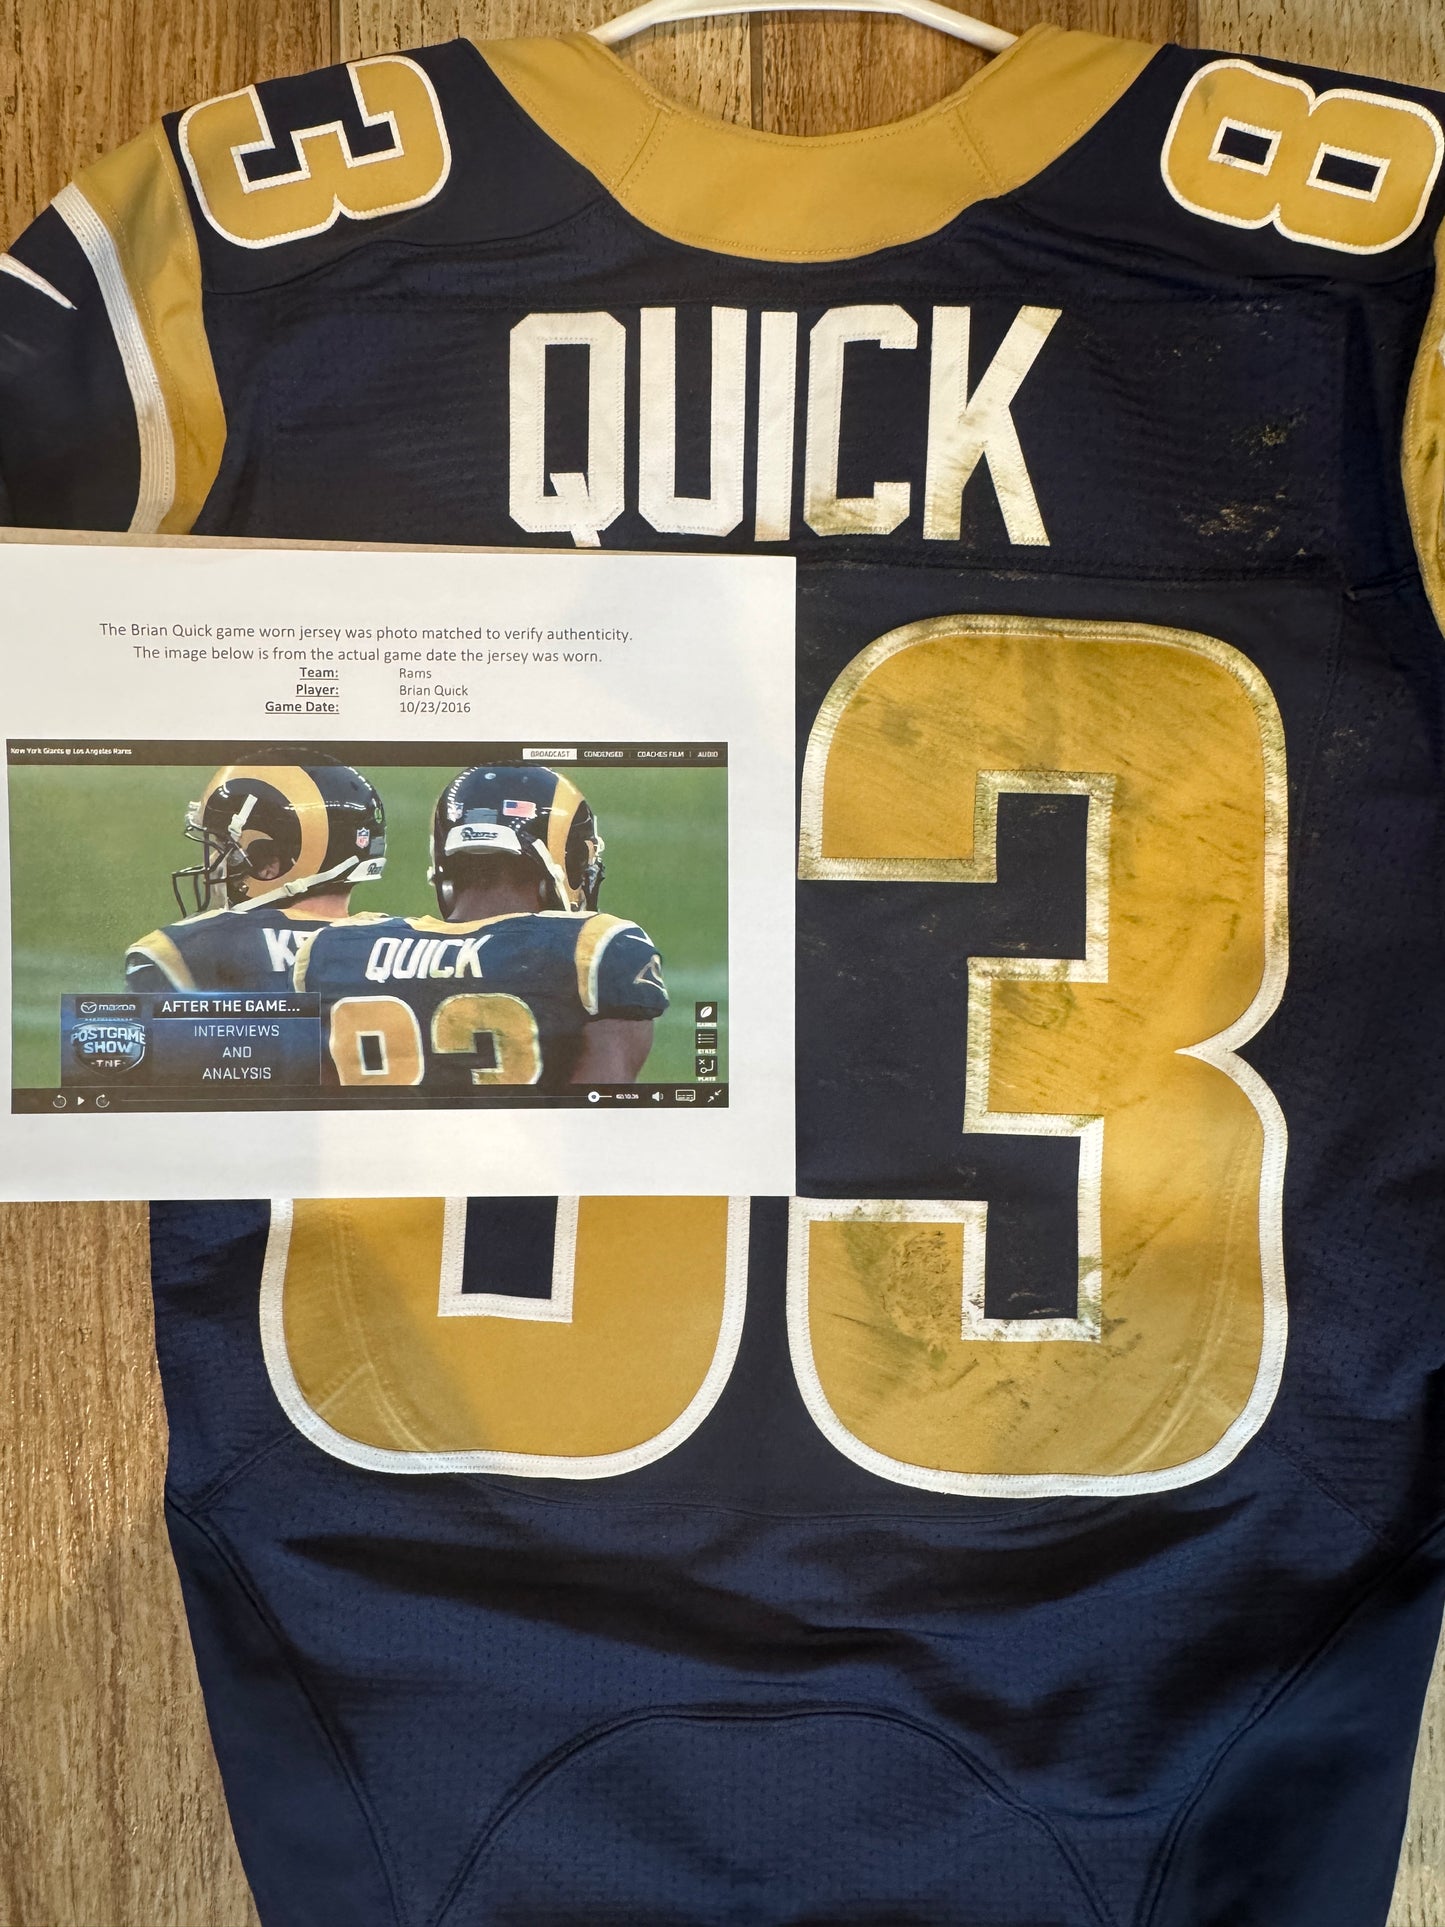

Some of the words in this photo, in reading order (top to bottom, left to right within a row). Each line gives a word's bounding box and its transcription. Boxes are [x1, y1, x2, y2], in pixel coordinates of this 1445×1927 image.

[178, 55, 452, 249] 3
[1161, 59, 1445, 255] 8
[508, 304, 1062, 548] QUICK
[99, 623, 127, 636] The
[131, 624, 168, 637] Brian
[172, 623, 212, 638] Quick
[216, 626, 255, 641] game
[259, 627, 295, 638] worn
[299, 625, 341, 642] jersey
[345, 628, 372, 639] was
[376, 627, 418, 642] photo
[422, 627, 482, 640] matched
[486, 629, 501, 640] to
[504, 627, 543, 643] verify
[547, 628, 633, 643] authenticity.
[133, 646, 160, 659] The
[165, 646, 207, 662] image
[211, 647, 254, 660] below
[258, 648, 269, 660] is
[273, 647, 307, 660] from
[311, 648, 334, 661] the
[338, 648, 380, 661] actual
[383, 651, 422, 664] game
[426, 648, 456, 662] date
[461, 648, 483, 662] the
[487, 649, 529, 665] jersey
[532, 652, 559, 663] was
[562, 652, 603, 663] worn.
[299, 667, 339, 679] Team:
[399, 667, 432, 679] Rams
[295, 684, 339, 697] Player:
[399, 684, 431, 696] Brian
[434, 684, 469, 697] Quick
[264, 701, 302, 713] Game
[305, 701, 339, 713] Date:
[399, 701, 471, 714] 10/23/2016
[27, 747, 42, 755] York
[43, 747, 65, 755] Giants
[73, 747, 84, 755] Los
[85, 747, 112, 756] Angeles
[530, 750, 570, 758] BROADCAST
[584, 750, 624, 758] CONDENSED
[637, 750, 668, 758] COACHES
[669, 750, 684, 758] FILM
[698, 750, 719, 758] AUDIO
[365, 934, 494, 983] QUICK
[98, 1003, 136, 1012] mazda
[162, 1000, 209, 1013] AFTER
[213, 1000, 242, 1013] THE
[245, 1000, 300, 1012] GAME...
[70, 1026, 146, 1045] POSTGAME
[194, 1025, 280, 1037] INTERVIEWS
[83, 1041, 132, 1054] SHOW
[222, 1046, 252, 1058] AND
[202, 1067, 272, 1080] ANALYSIS
